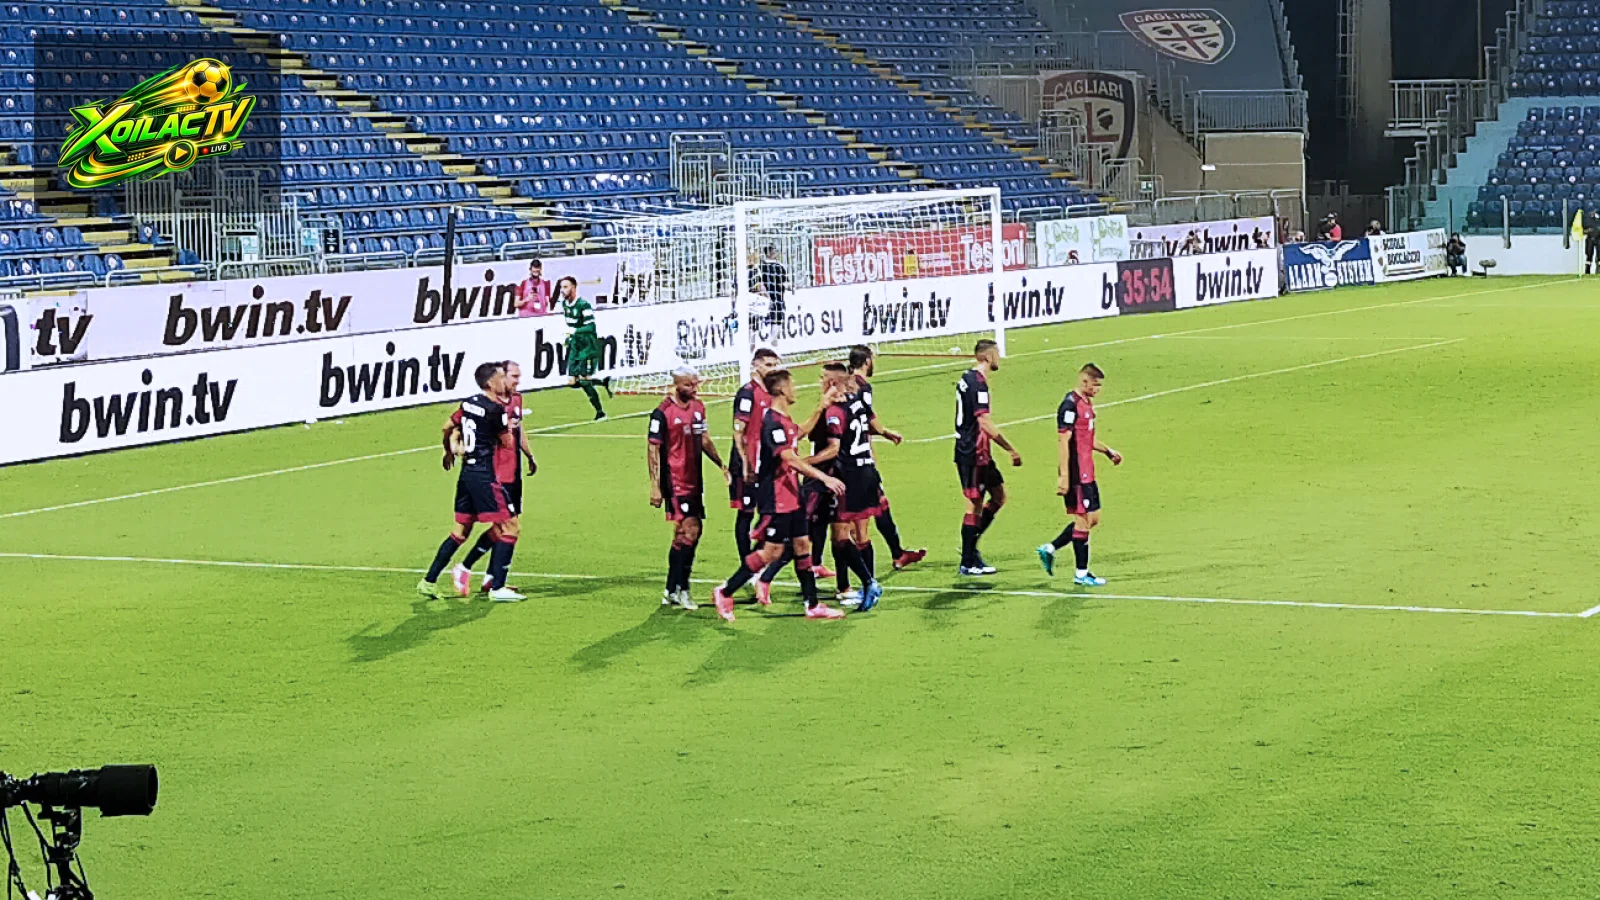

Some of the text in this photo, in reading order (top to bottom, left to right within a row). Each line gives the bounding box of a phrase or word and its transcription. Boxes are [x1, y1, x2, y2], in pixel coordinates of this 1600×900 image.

[1054, 79, 1123, 100] CAGLIARI
[818, 241, 894, 286] Testoni
[960, 230, 1025, 273] Tesoni
[1122, 266, 1172, 305] 35:54
[1196, 256, 1264, 302] bwin.tv
[1288, 263, 1322, 290] ALARM
[1337, 259, 1373, 285] SYSTEM
[163, 285, 352, 345] bwin.tv
[821, 309, 843, 334] su
[862, 287, 951, 336] bwin.tv
[319, 341, 465, 408] bwin.tv
[59, 368, 238, 443] bwin.tv
